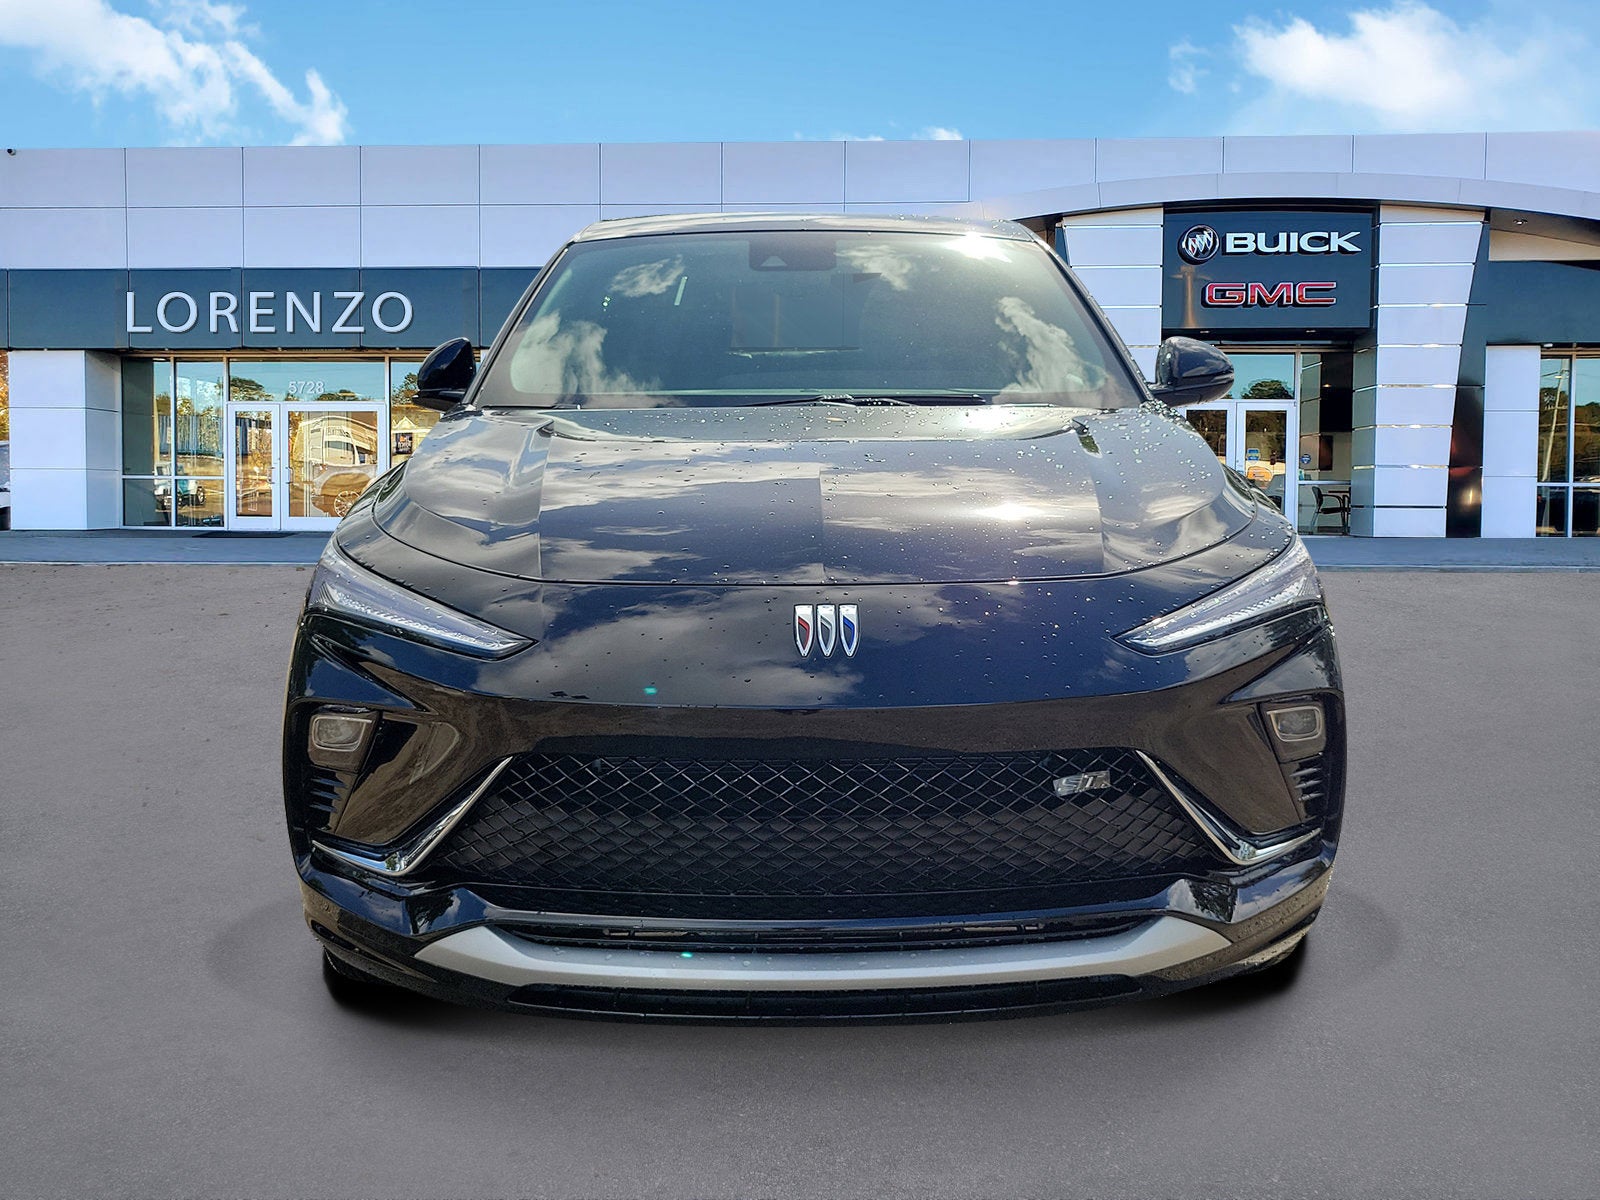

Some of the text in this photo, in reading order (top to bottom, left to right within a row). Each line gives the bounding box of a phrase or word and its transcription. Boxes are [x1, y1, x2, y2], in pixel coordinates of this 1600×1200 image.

[1225, 231, 1361, 253] BUICK
[1206, 282, 1337, 305] GMC
[126, 291, 413, 333] LORENZO
[288, 381, 325, 394] 5728
